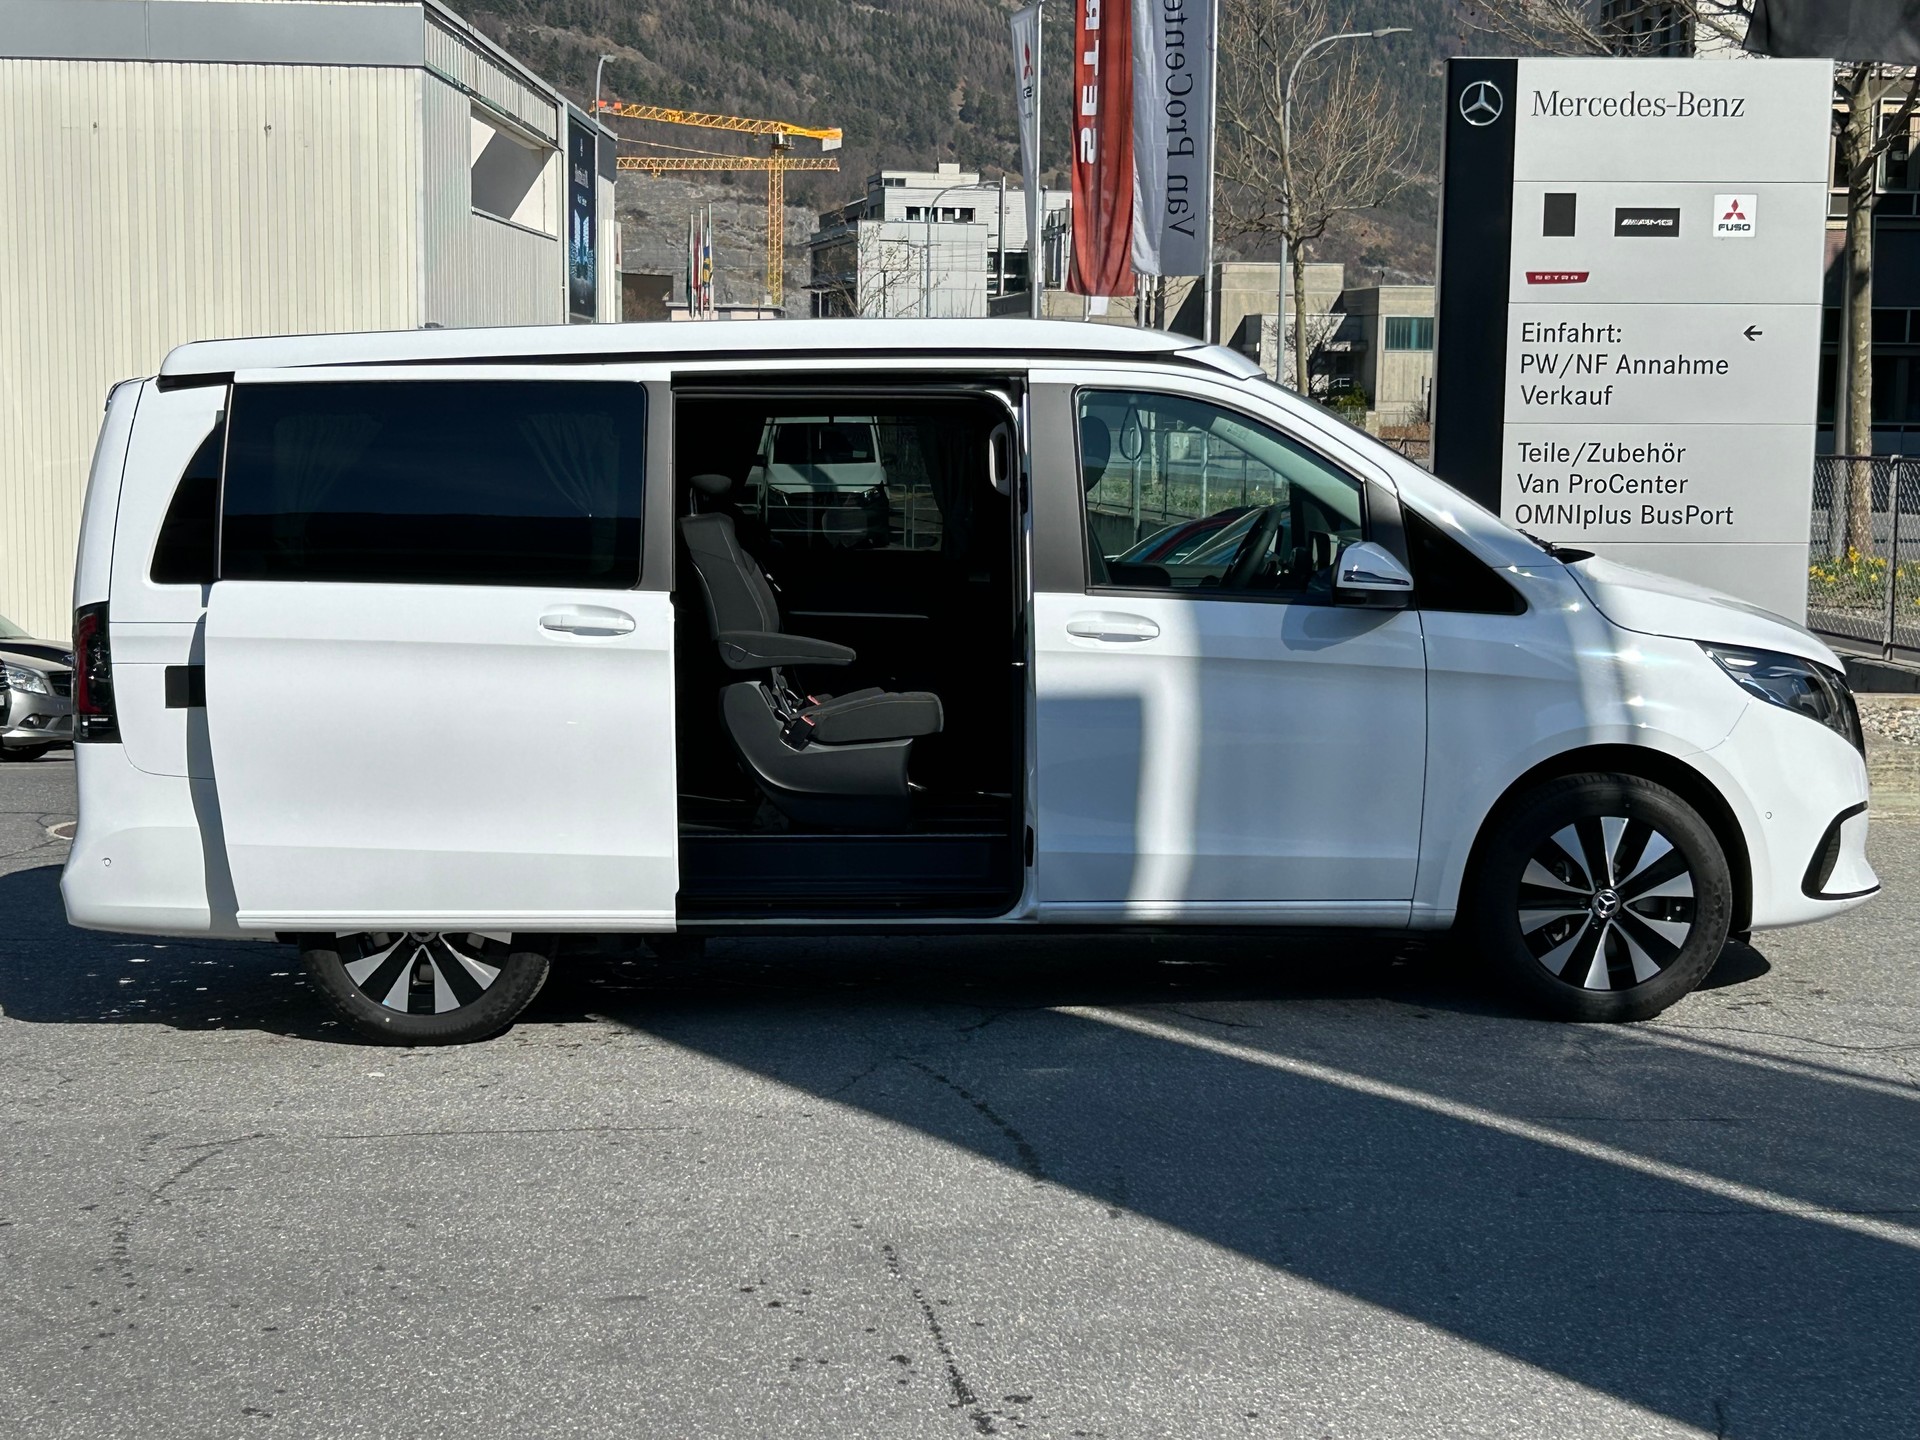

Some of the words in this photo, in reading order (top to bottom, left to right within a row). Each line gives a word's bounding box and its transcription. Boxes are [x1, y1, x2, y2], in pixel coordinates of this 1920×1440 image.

[1531, 90, 1745, 118] Mercedes-Benz
[1718, 222, 1751, 232] FUSO
[1521, 321, 1622, 343] Einfahrt:
[1520, 353, 1609, 379] PW/NF
[1615, 353, 1729, 375] Annahme
[1520, 384, 1614, 406] Verkauf
[1517, 441, 1687, 468] Teile/Zubehör
[1516, 473, 1560, 494] Van
[1568, 473, 1689, 494] ProCenter
[1515, 503, 1632, 530] OMNIplus
[1640, 504, 1735, 526] BusPort
